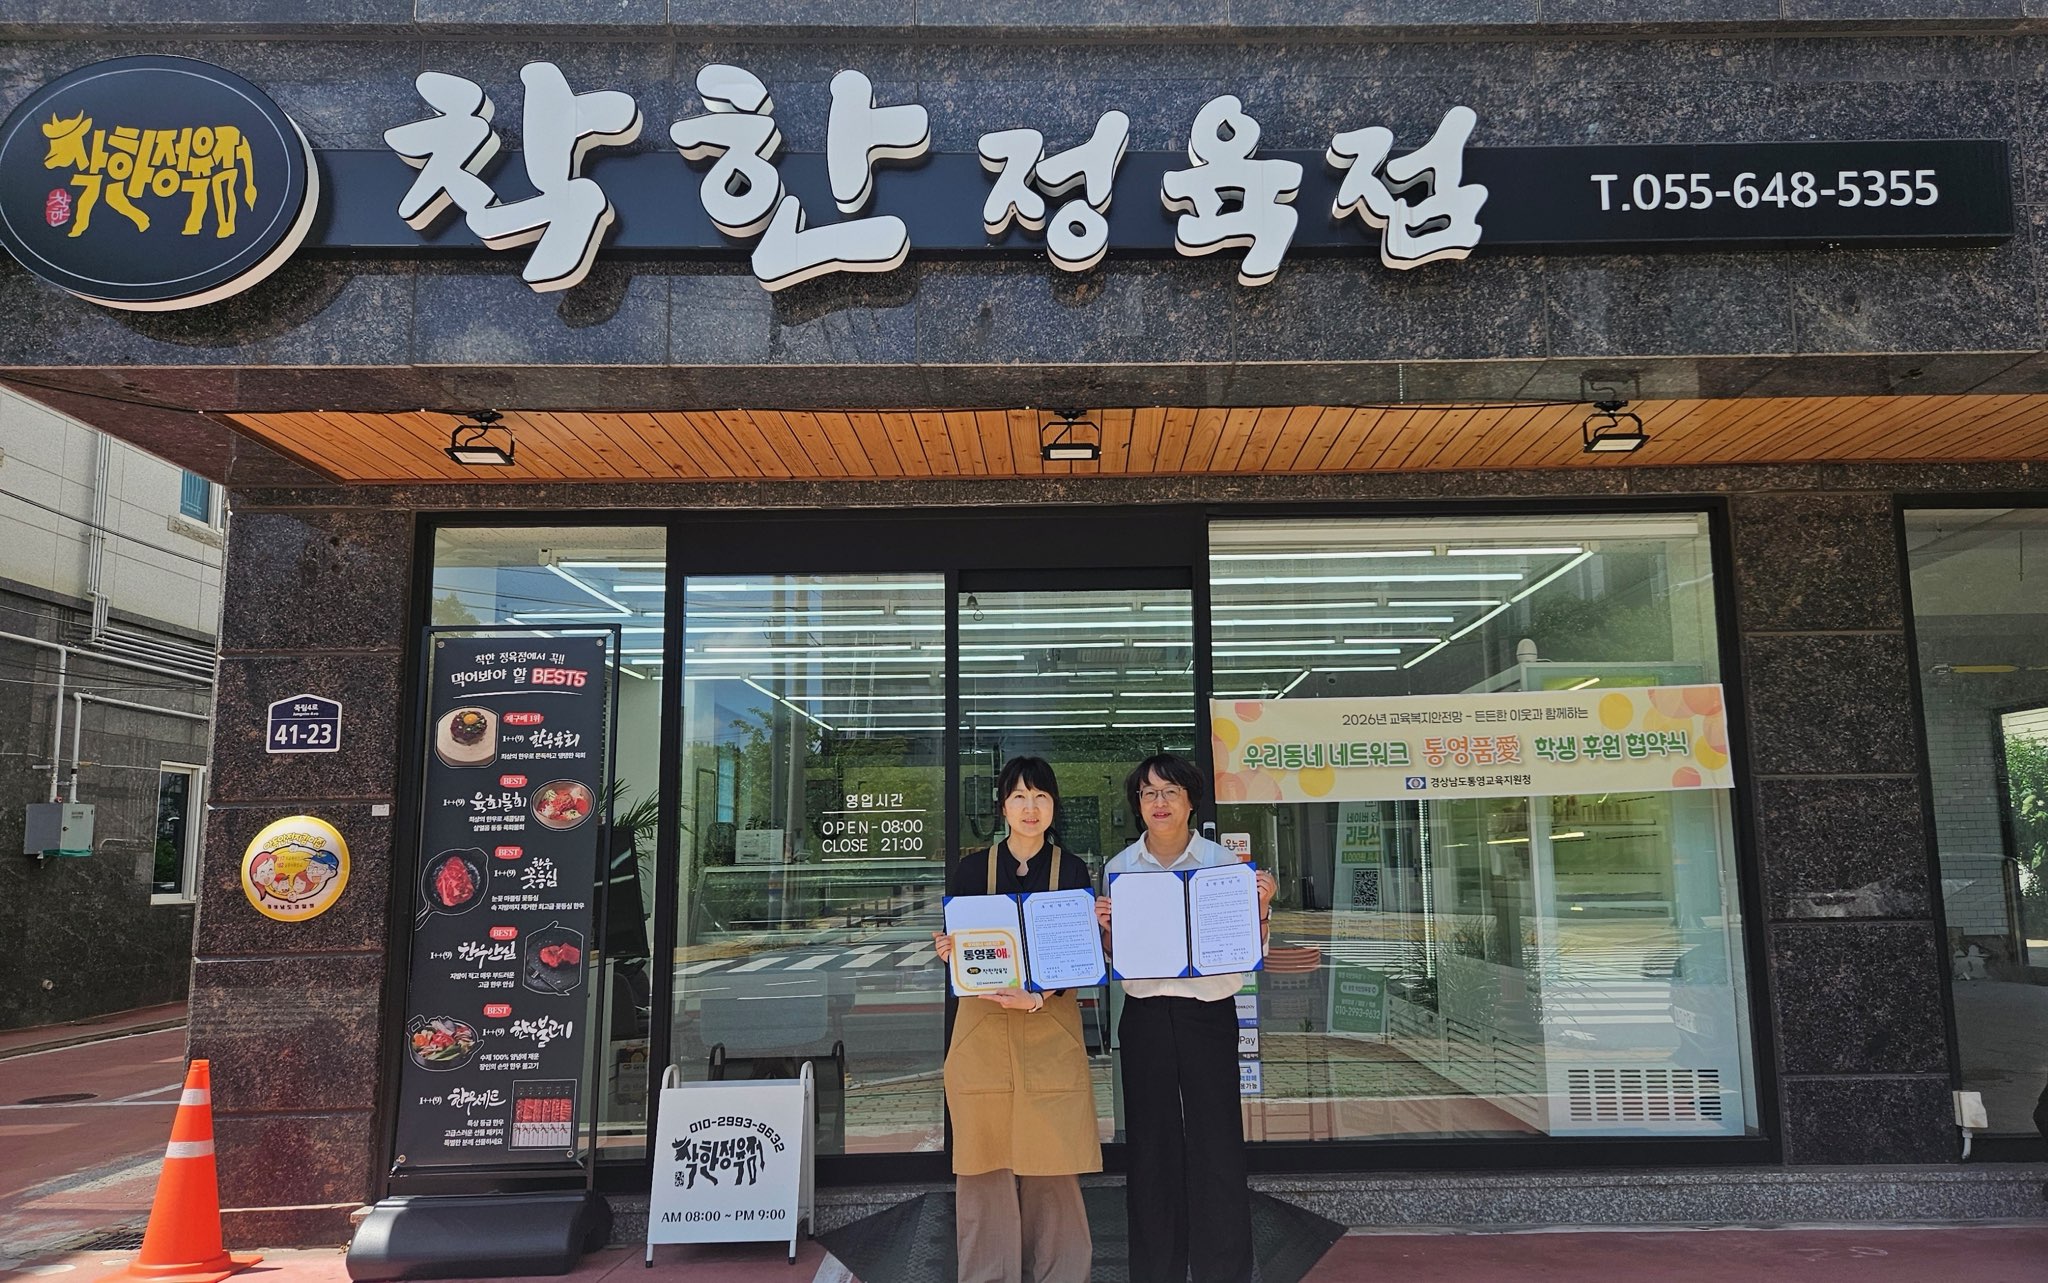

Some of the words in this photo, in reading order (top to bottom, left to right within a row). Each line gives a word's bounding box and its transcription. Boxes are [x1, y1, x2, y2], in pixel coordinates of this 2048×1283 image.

[43, 109, 258, 238] 착한정육점
[1591, 169, 1939, 211] T.055-648-5355
[475, 653, 495, 665] 착한
[499, 651, 546, 664] 정육점에서
[549, 652, 565, 665] 꼭!!
[451, 668, 507, 688] 먹어봐야
[513, 667, 528, 684] 할
[531, 667, 588, 687] BEST5
[505, 714, 528, 723] 재구매
[530, 713, 541, 723] 1위
[1342, 712, 1387, 726] 2026년
[1390, 711, 1463, 725] 교육복지안전망
[1475, 710, 1507, 723] 든든한
[1510, 708, 1543, 722] 이웃과
[1546, 707, 1588, 721] 함께하는
[274, 723, 332, 745] 41-23
[502, 734, 525, 743] 1++(9)
[529, 728, 580, 749] 한우육회
[1243, 742, 1323, 769] 우리동네
[1328, 741, 1409, 767] 네트워크
[1422, 734, 1521, 768] 통영품愛
[1534, 735, 1577, 761] 학생
[1582, 733, 1622, 760] 후원
[1625, 730, 1689, 757] 협약식
[503, 777, 523, 785] BEST
[1430, 774, 1531, 788] 경상남도통영교육지원청
[443, 798, 465, 807] 1++(9)
[469, 791, 527, 814] 육회물회
[846, 793, 903, 808] 영업시간
[498, 848, 520, 857] BEST
[822, 838, 868, 853] CLOSE
[881, 837, 923, 852] 21:00
[531, 857, 553, 870] 한우
[494, 869, 516, 877] 1++(9)
[520, 867, 557, 890] 꽃등심
[493, 929, 513, 937] BEST
[430, 951, 453, 960] 1++(9)
[457, 941, 517, 969] 한우안심
[963, 948, 1008, 961] 통영품애
[487, 1007, 508, 1015] BEST
[1335, 1005, 1380, 1019] 010-2993-9632
[482, 1028, 505, 1037] 1++(9)
[509, 1015, 573, 1048] 한우불고기
[1240, 1035, 1256, 1046] Pay
[419, 1096, 443, 1106] 1++(9)
[447, 1087, 506, 1116] 한우세트
[689, 1116, 785, 1153] 010-2993-9632
[661, 1211, 682, 1223] AM
[685, 1210, 721, 1222] 08:00
[735, 1210, 754, 1221] PM
[758, 1209, 786, 1221] 9:00
